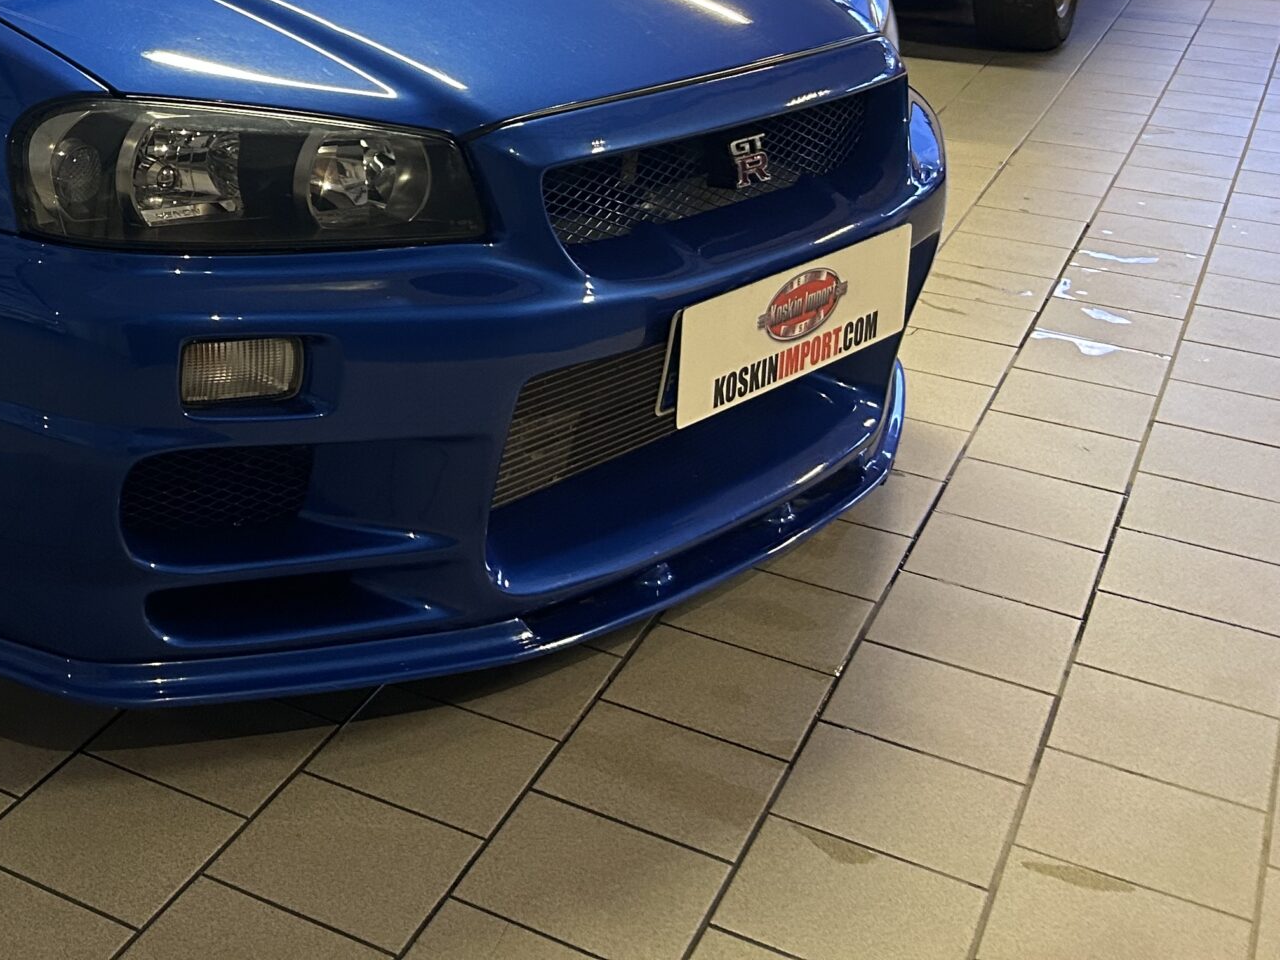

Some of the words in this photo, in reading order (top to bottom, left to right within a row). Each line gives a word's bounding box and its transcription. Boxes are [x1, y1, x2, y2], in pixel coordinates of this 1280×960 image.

[730, 133, 765, 155] GT
[735, 151, 772, 188] R
[713, 311, 879, 409] KOSKINIMPORT.COM
